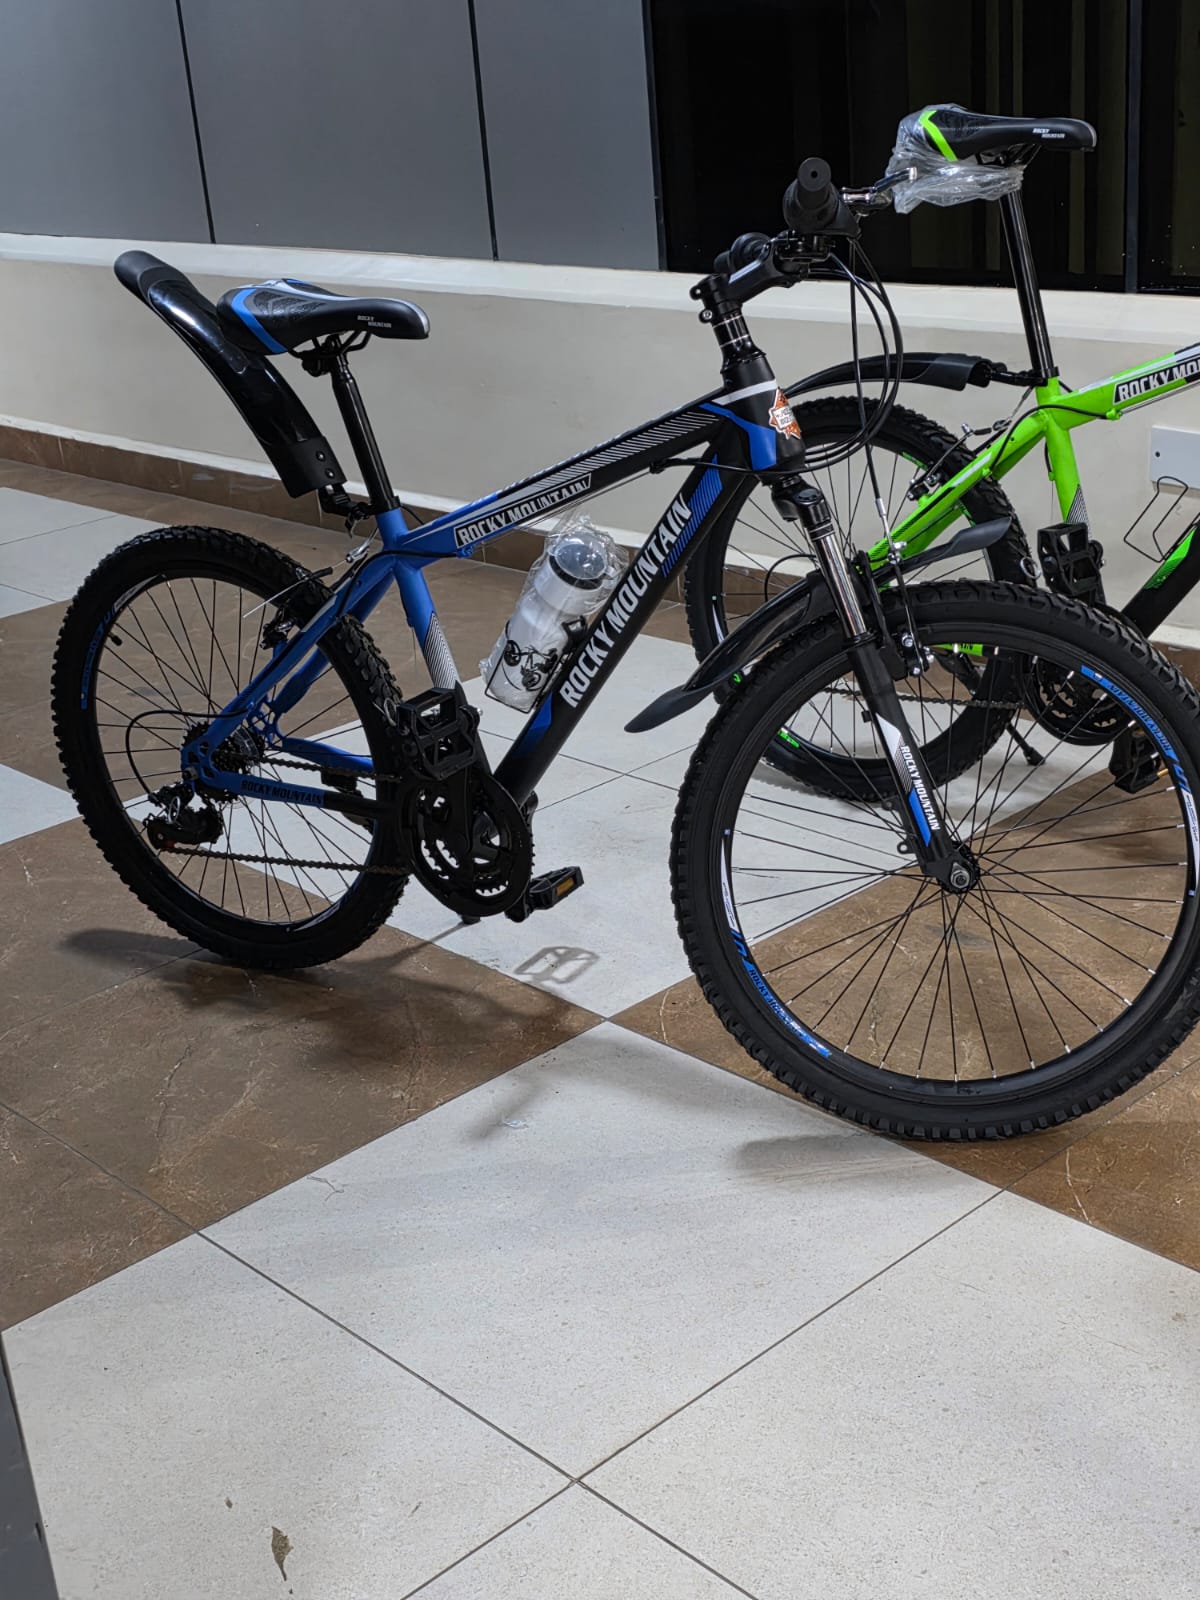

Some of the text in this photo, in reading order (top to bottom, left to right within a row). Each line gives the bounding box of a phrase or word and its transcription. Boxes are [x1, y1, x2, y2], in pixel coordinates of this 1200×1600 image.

[1118, 359, 1200, 401] ROCKY MO
[457, 480, 588, 545] ROCKY MOUNTAIN
[559, 493, 692, 708] ROCKY MOUNTAIN
[241, 780, 322, 804] ROCKY MOUNTAIN
[900, 745, 940, 830] ROCKY MOUNTAIN
